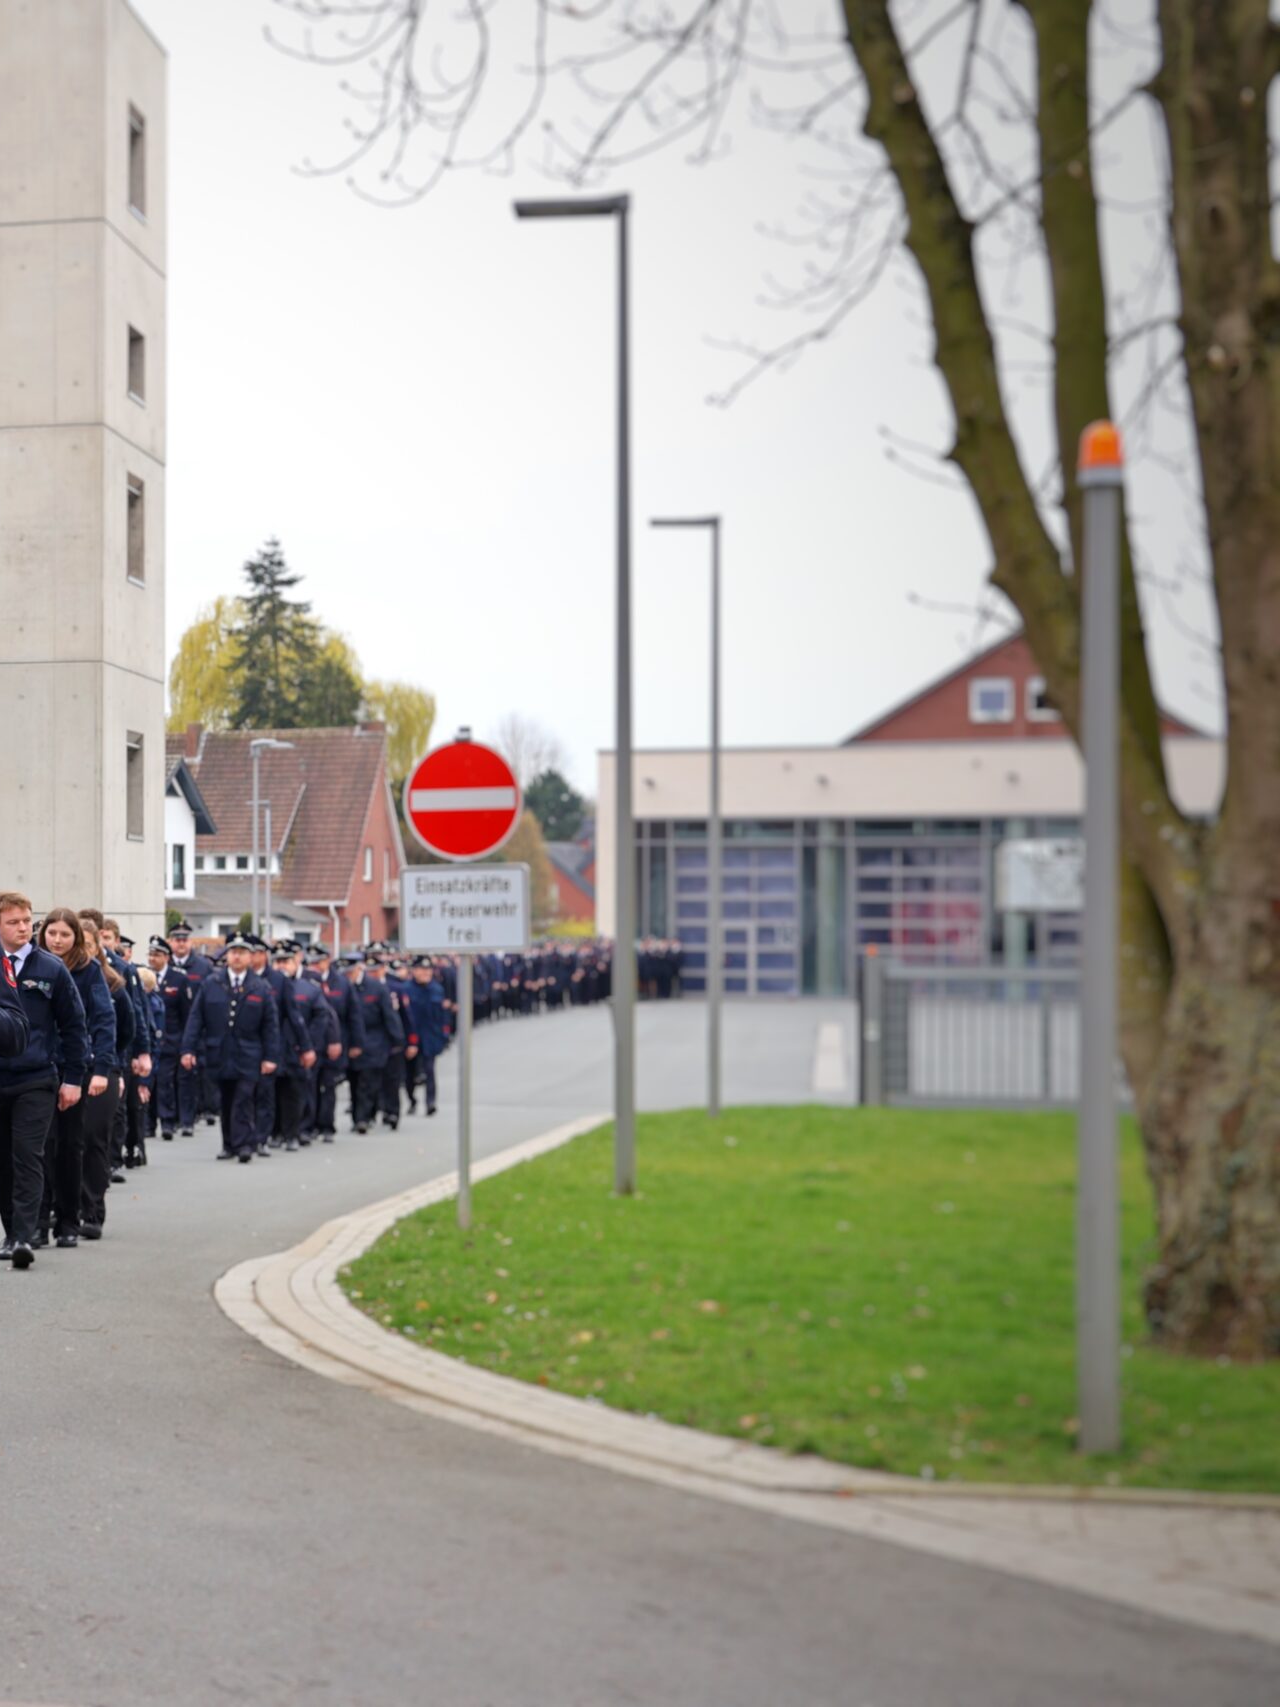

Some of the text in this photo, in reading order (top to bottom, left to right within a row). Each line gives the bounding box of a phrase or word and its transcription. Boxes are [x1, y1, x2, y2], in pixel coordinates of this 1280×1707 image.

[415, 876, 512, 894] Einsatzkräfte
[409, 901, 518, 919] der Feuerwehr
[447, 925, 482, 944] frei
